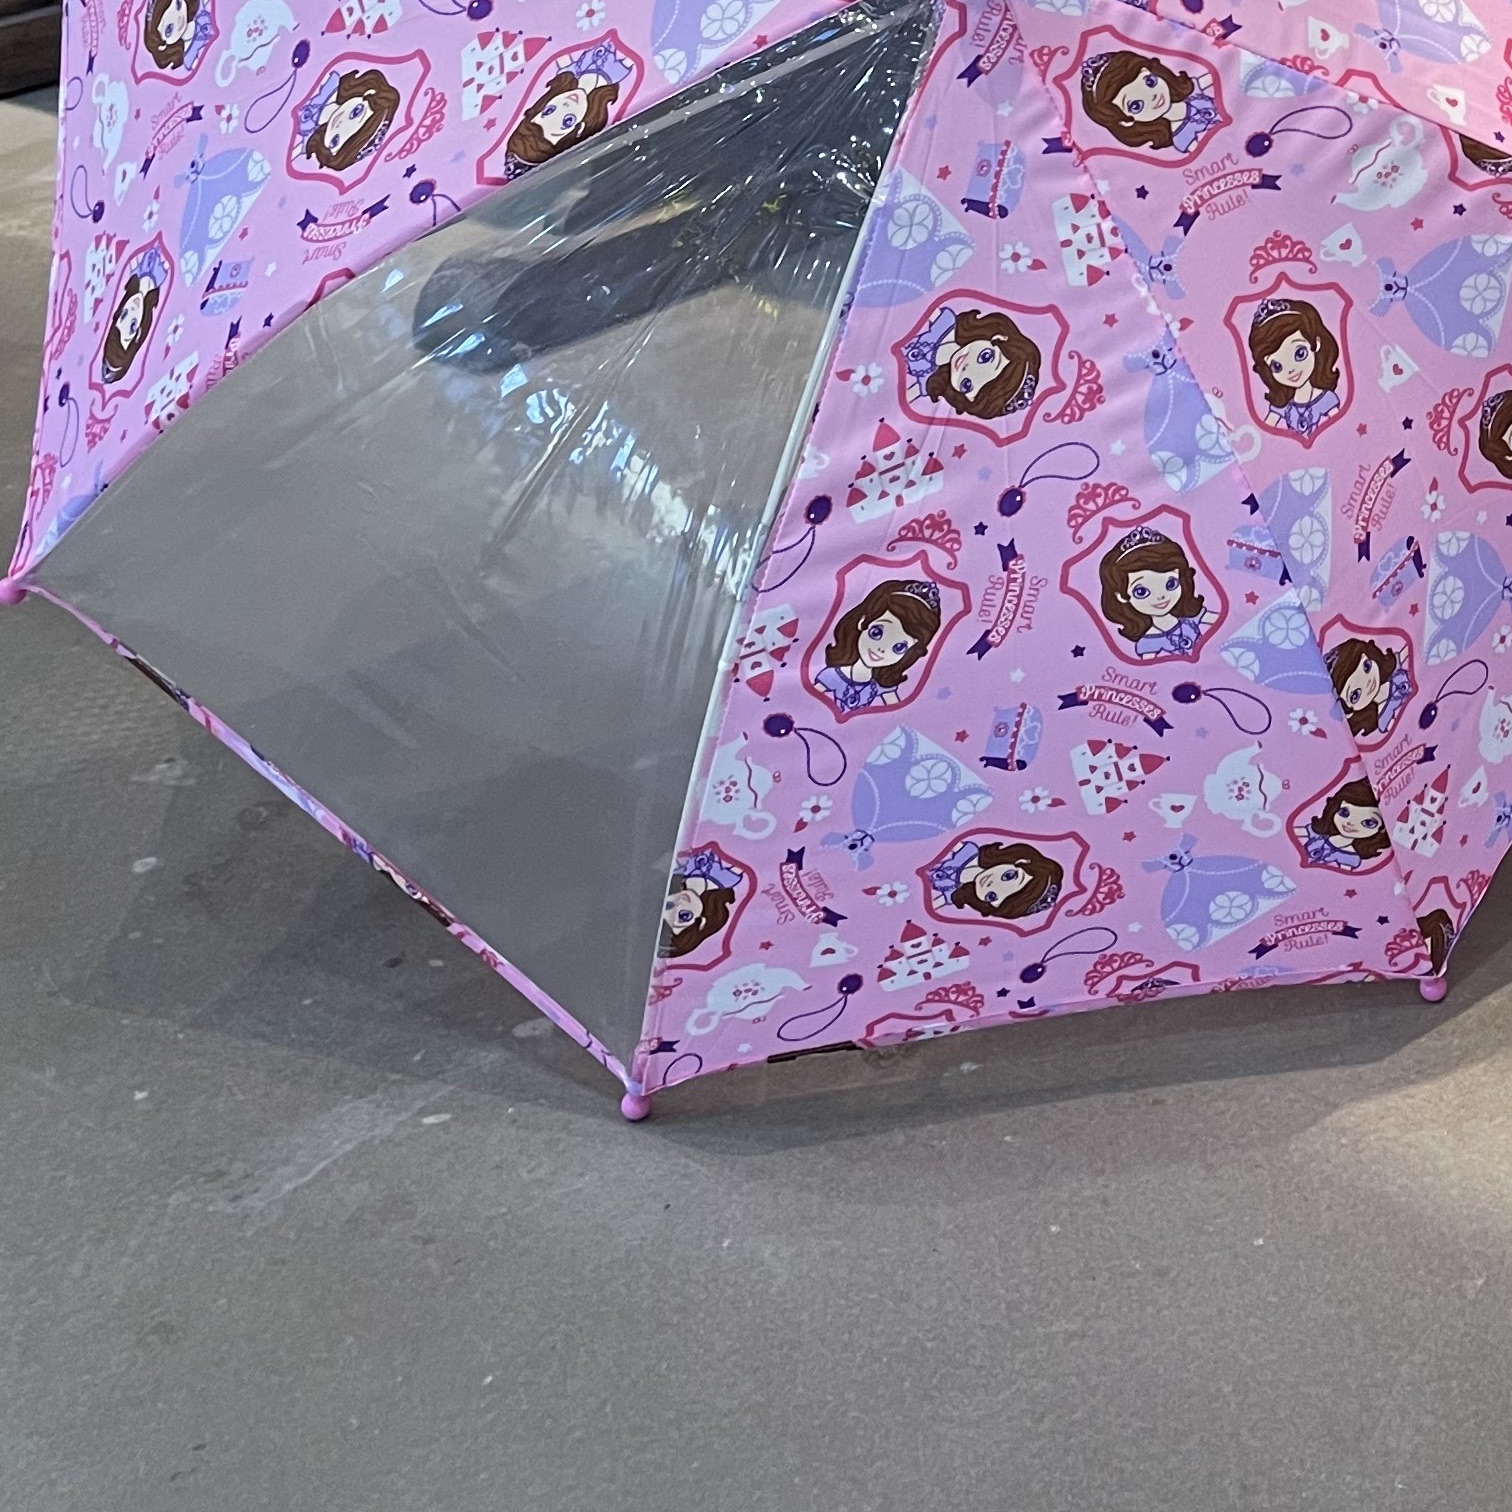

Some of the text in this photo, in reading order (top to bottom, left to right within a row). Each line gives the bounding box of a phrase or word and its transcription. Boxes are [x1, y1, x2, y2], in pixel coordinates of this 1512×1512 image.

[970, 1, 1001, 48] Rule!
[1008, 34, 1027, 65] art
[1183, 153, 1239, 186] Smart
[1183, 170, 1262, 216] Princesses
[1206, 190, 1250, 221] Rule!
[1341, 463, 1371, 519] Smart
[1354, 459, 1394, 541] Princesses
[1372, 484, 1396, 531] Rule!
[977, 575, 1005, 623] Rule!
[987, 558, 1026, 643] Princesses
[1017, 575, 1048, 634] Smart
[1102, 666, 1159, 696] Smart
[1080, 684, 1163, 721] Princesses
[1089, 704, 1138, 728] Rule!
[1373, 734, 1412, 776] Smart
[1385, 767, 1416, 806] Rule!
[1264, 920, 1346, 945] Princesses
[1274, 908, 1330, 927] Smart
[1284, 934, 1329, 953] Rule!
